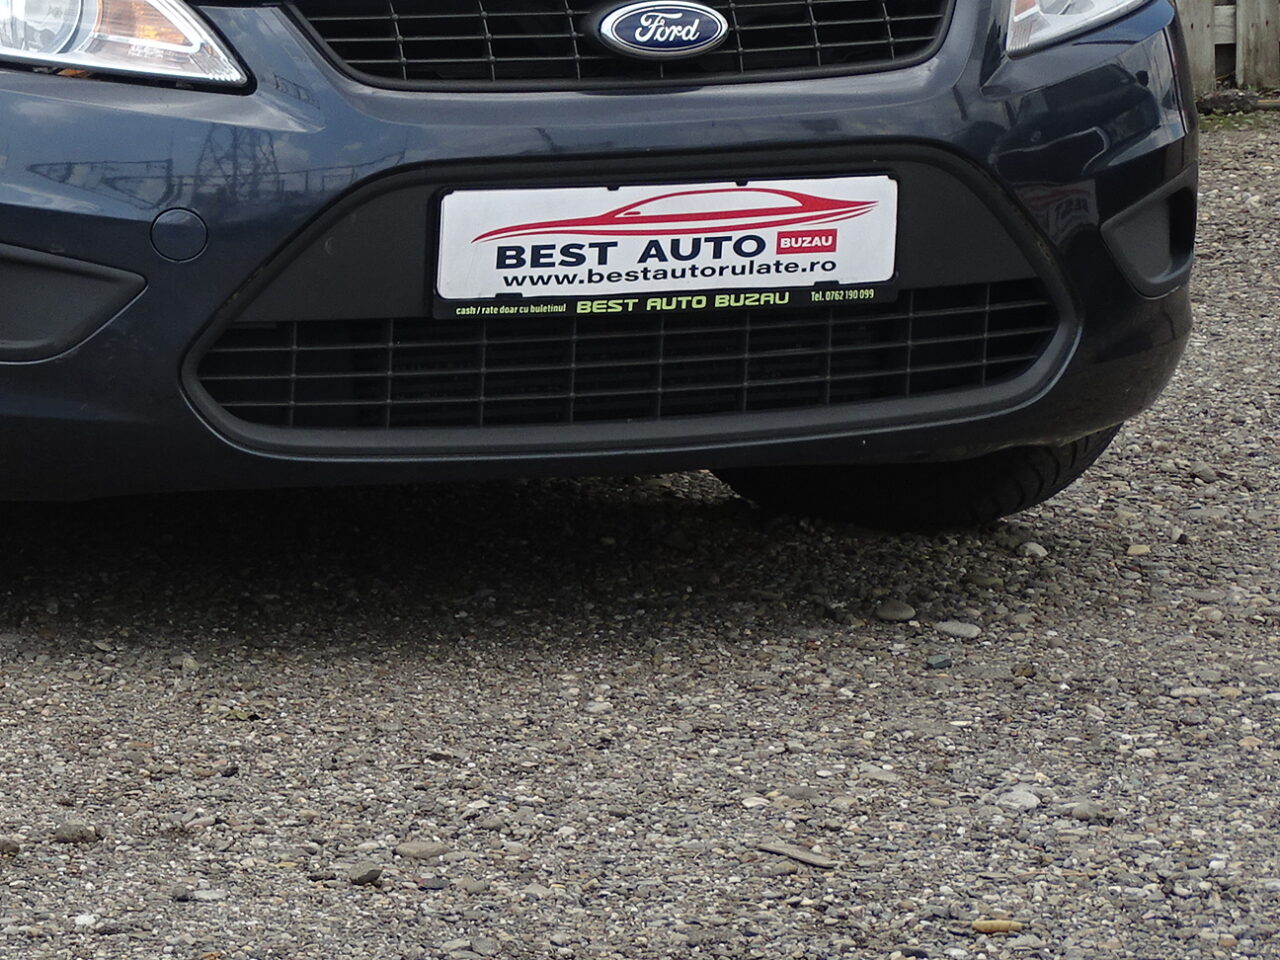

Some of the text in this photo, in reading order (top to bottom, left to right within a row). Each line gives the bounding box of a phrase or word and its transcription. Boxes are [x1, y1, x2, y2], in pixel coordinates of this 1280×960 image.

[635, 12, 700, 42] Ford
[496, 235, 833, 269] BEST AUTO BUZAU
[503, 260, 837, 287] www.bestautorulate.ro
[500, 305, 518, 314] doar
[519, 305, 529, 314] cu
[530, 303, 567, 314] buletinul
[576, 298, 639, 314] BEST
[646, 295, 707, 311] AUTO
[714, 291, 790, 308] BUZAU
[811, 290, 824, 301] Tel.
[825, 290, 844, 301] 0762
